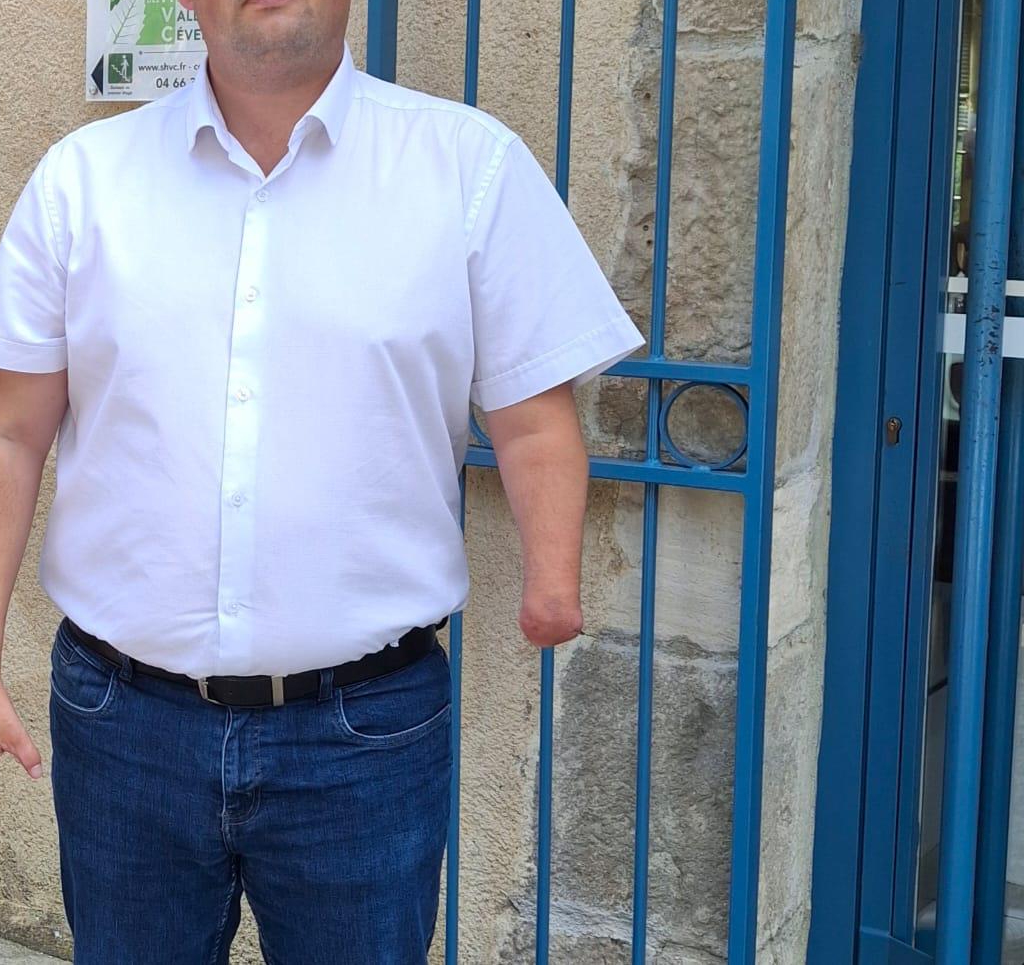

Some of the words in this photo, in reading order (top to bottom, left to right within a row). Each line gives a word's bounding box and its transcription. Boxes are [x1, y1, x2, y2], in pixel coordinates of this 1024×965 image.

[161, 25, 204, 43] CÉVE
[138, 62, 186, 71] www.shvc.fr
[156, 77, 169, 89] 04
[172, 77, 186, 88] 66
